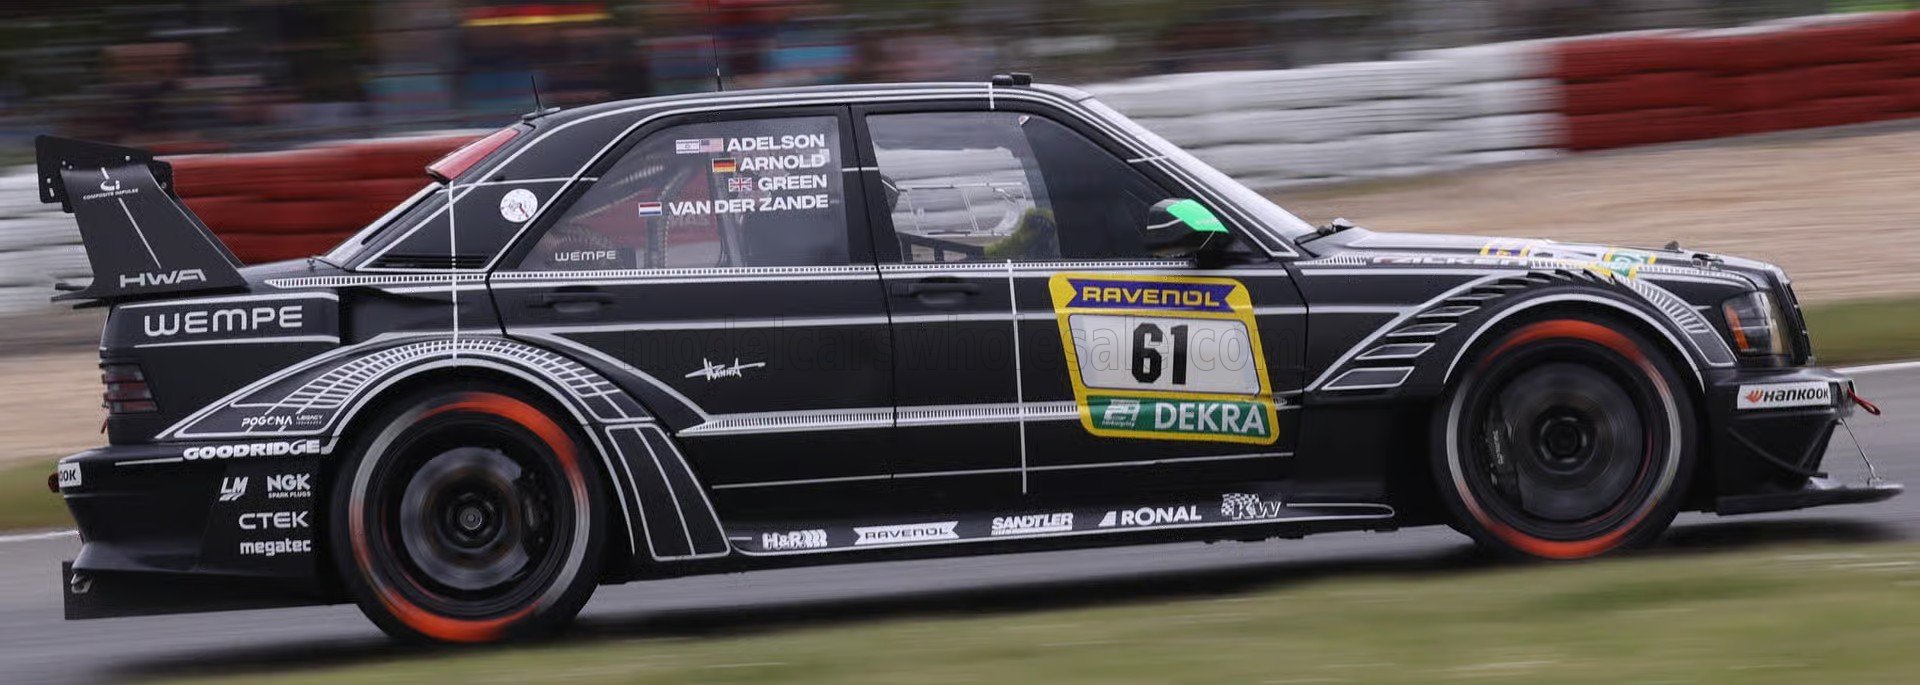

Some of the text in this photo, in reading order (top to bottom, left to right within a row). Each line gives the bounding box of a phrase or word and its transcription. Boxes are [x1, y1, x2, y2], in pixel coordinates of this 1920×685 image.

[727, 134, 825, 152] ADELSON
[740, 154, 826, 172] ARNOLD
[758, 174, 828, 191] GREEN
[82, 191, 114, 200] COMPOSITE
[669, 195, 829, 217] VAN DER ZANDE
[554, 250, 617, 262] WEMPE
[120, 269, 207, 288] HWA
[1082, 286, 1220, 307] RAVENOL
[144, 305, 303, 337] WEMPE
[1131, 322, 1188, 386] 61
[1154, 402, 1266, 435] DEKRA
[183, 439, 321, 460] GOODRIDGE
[221, 477, 248, 494] LM
[267, 473, 311, 492] NGK
[1121, 505, 1202, 526] RONAL
[1232, 501, 1281, 520] KW
[239, 511, 310, 530] CTEK
[991, 513, 1073, 530] SANDTLER
[865, 526, 948, 539] RAVENOL
[240, 538, 311, 557] megatec
